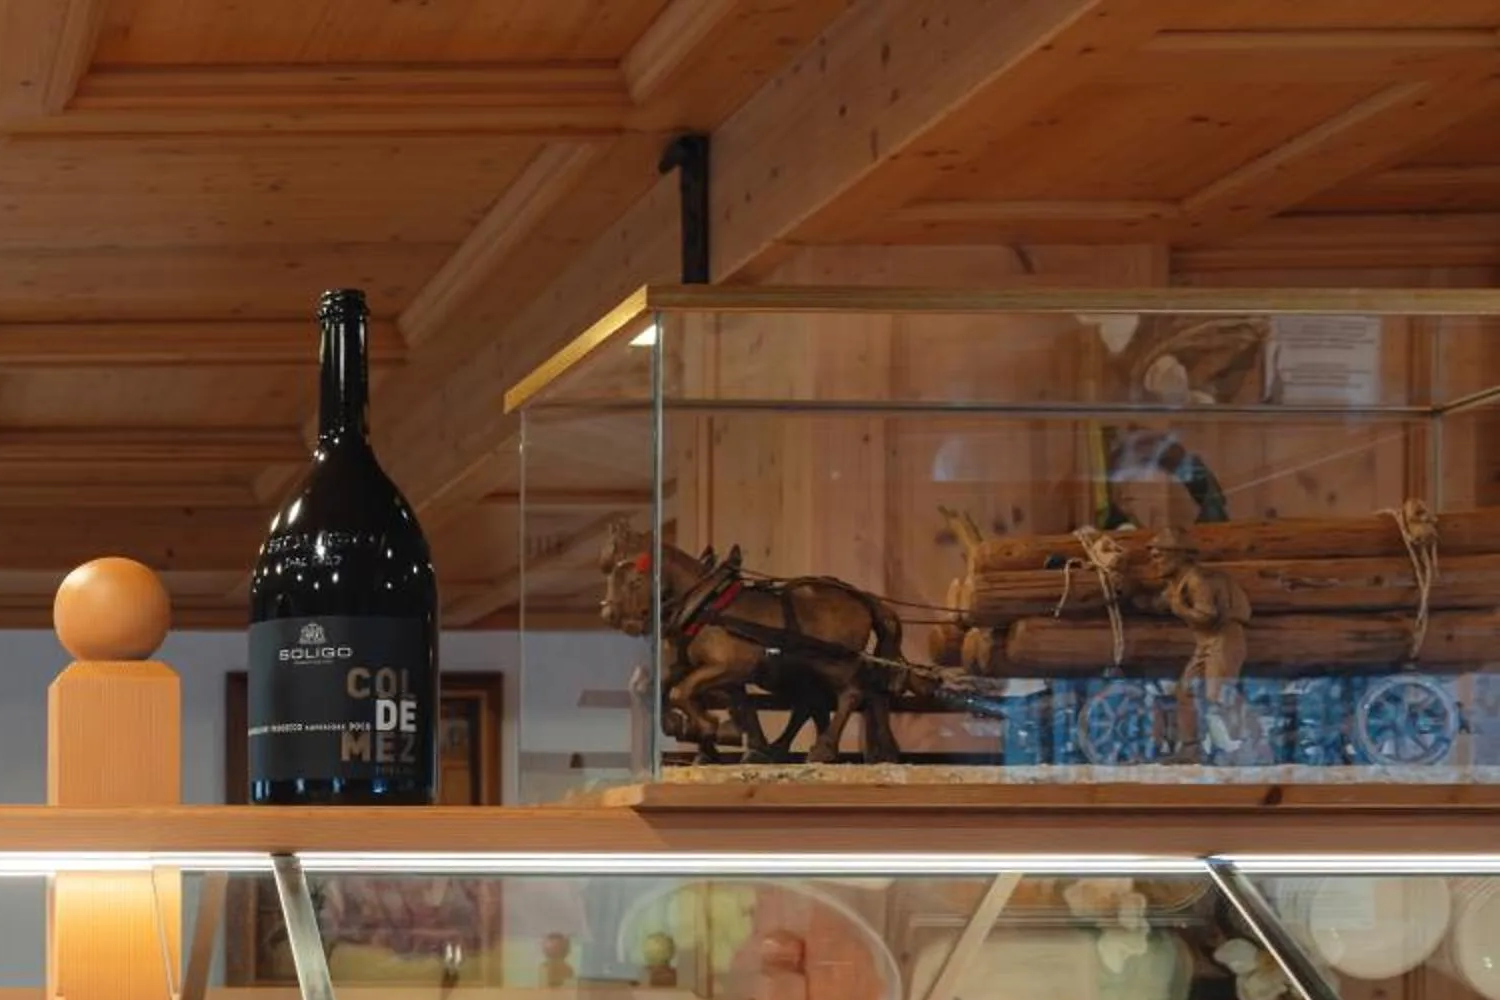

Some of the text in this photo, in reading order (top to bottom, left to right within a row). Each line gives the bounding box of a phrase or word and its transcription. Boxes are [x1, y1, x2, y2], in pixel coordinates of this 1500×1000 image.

[278, 647, 353, 661] SOLIGO
[347, 667, 416, 699] COL
[375, 699, 417, 732] DE
